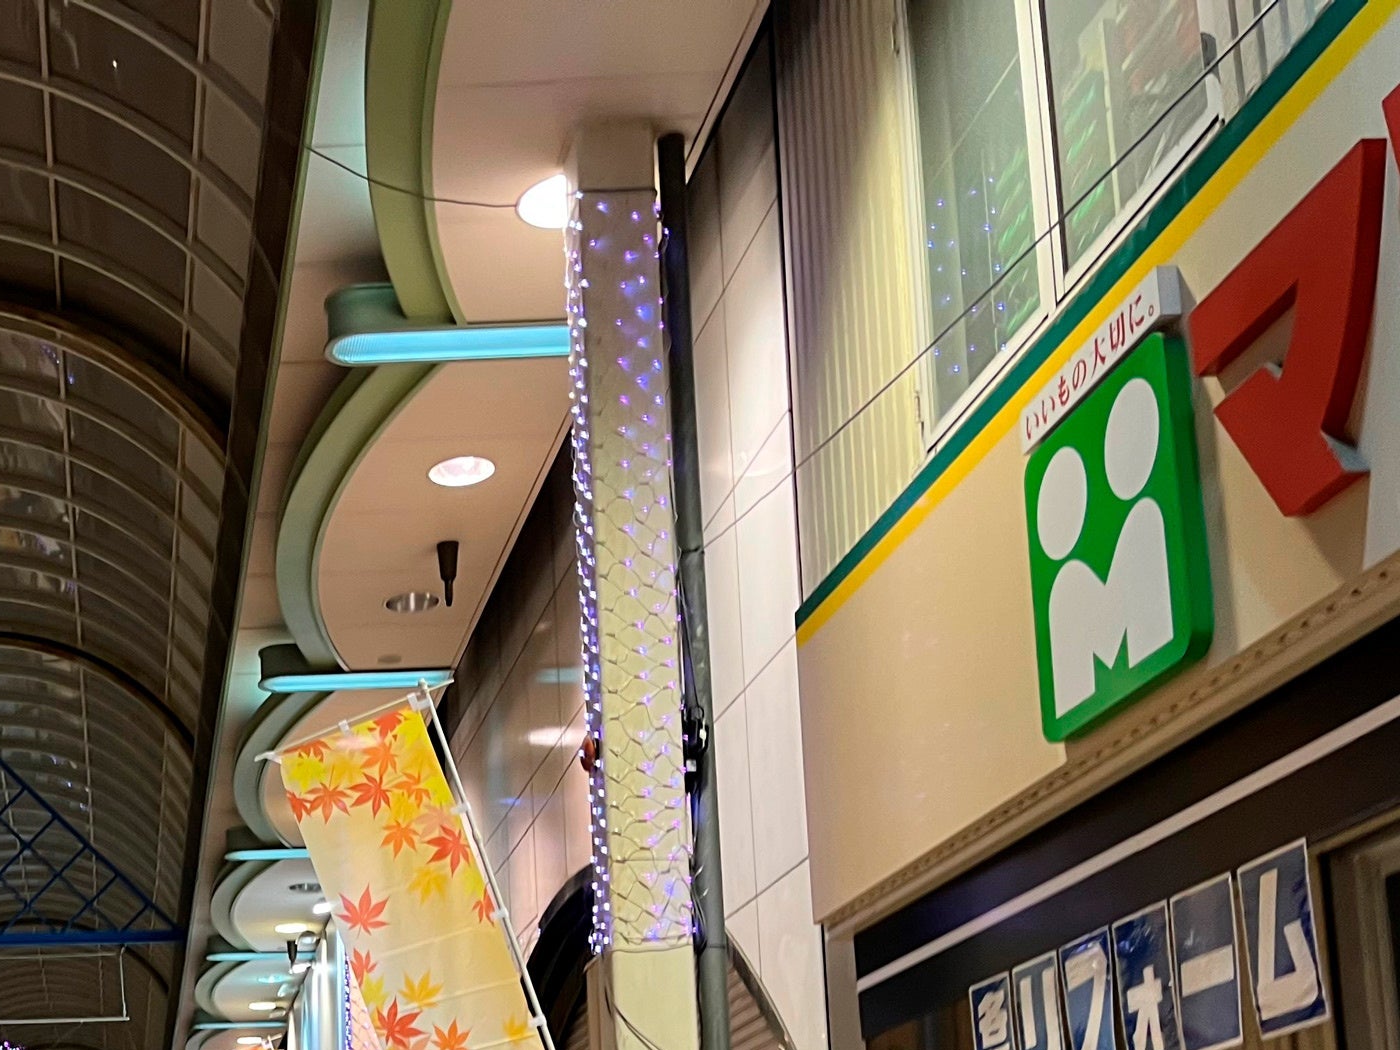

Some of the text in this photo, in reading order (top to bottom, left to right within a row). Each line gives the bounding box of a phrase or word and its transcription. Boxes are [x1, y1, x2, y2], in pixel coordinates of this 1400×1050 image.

[1025, 294, 1155, 441] いいもの大切に。
